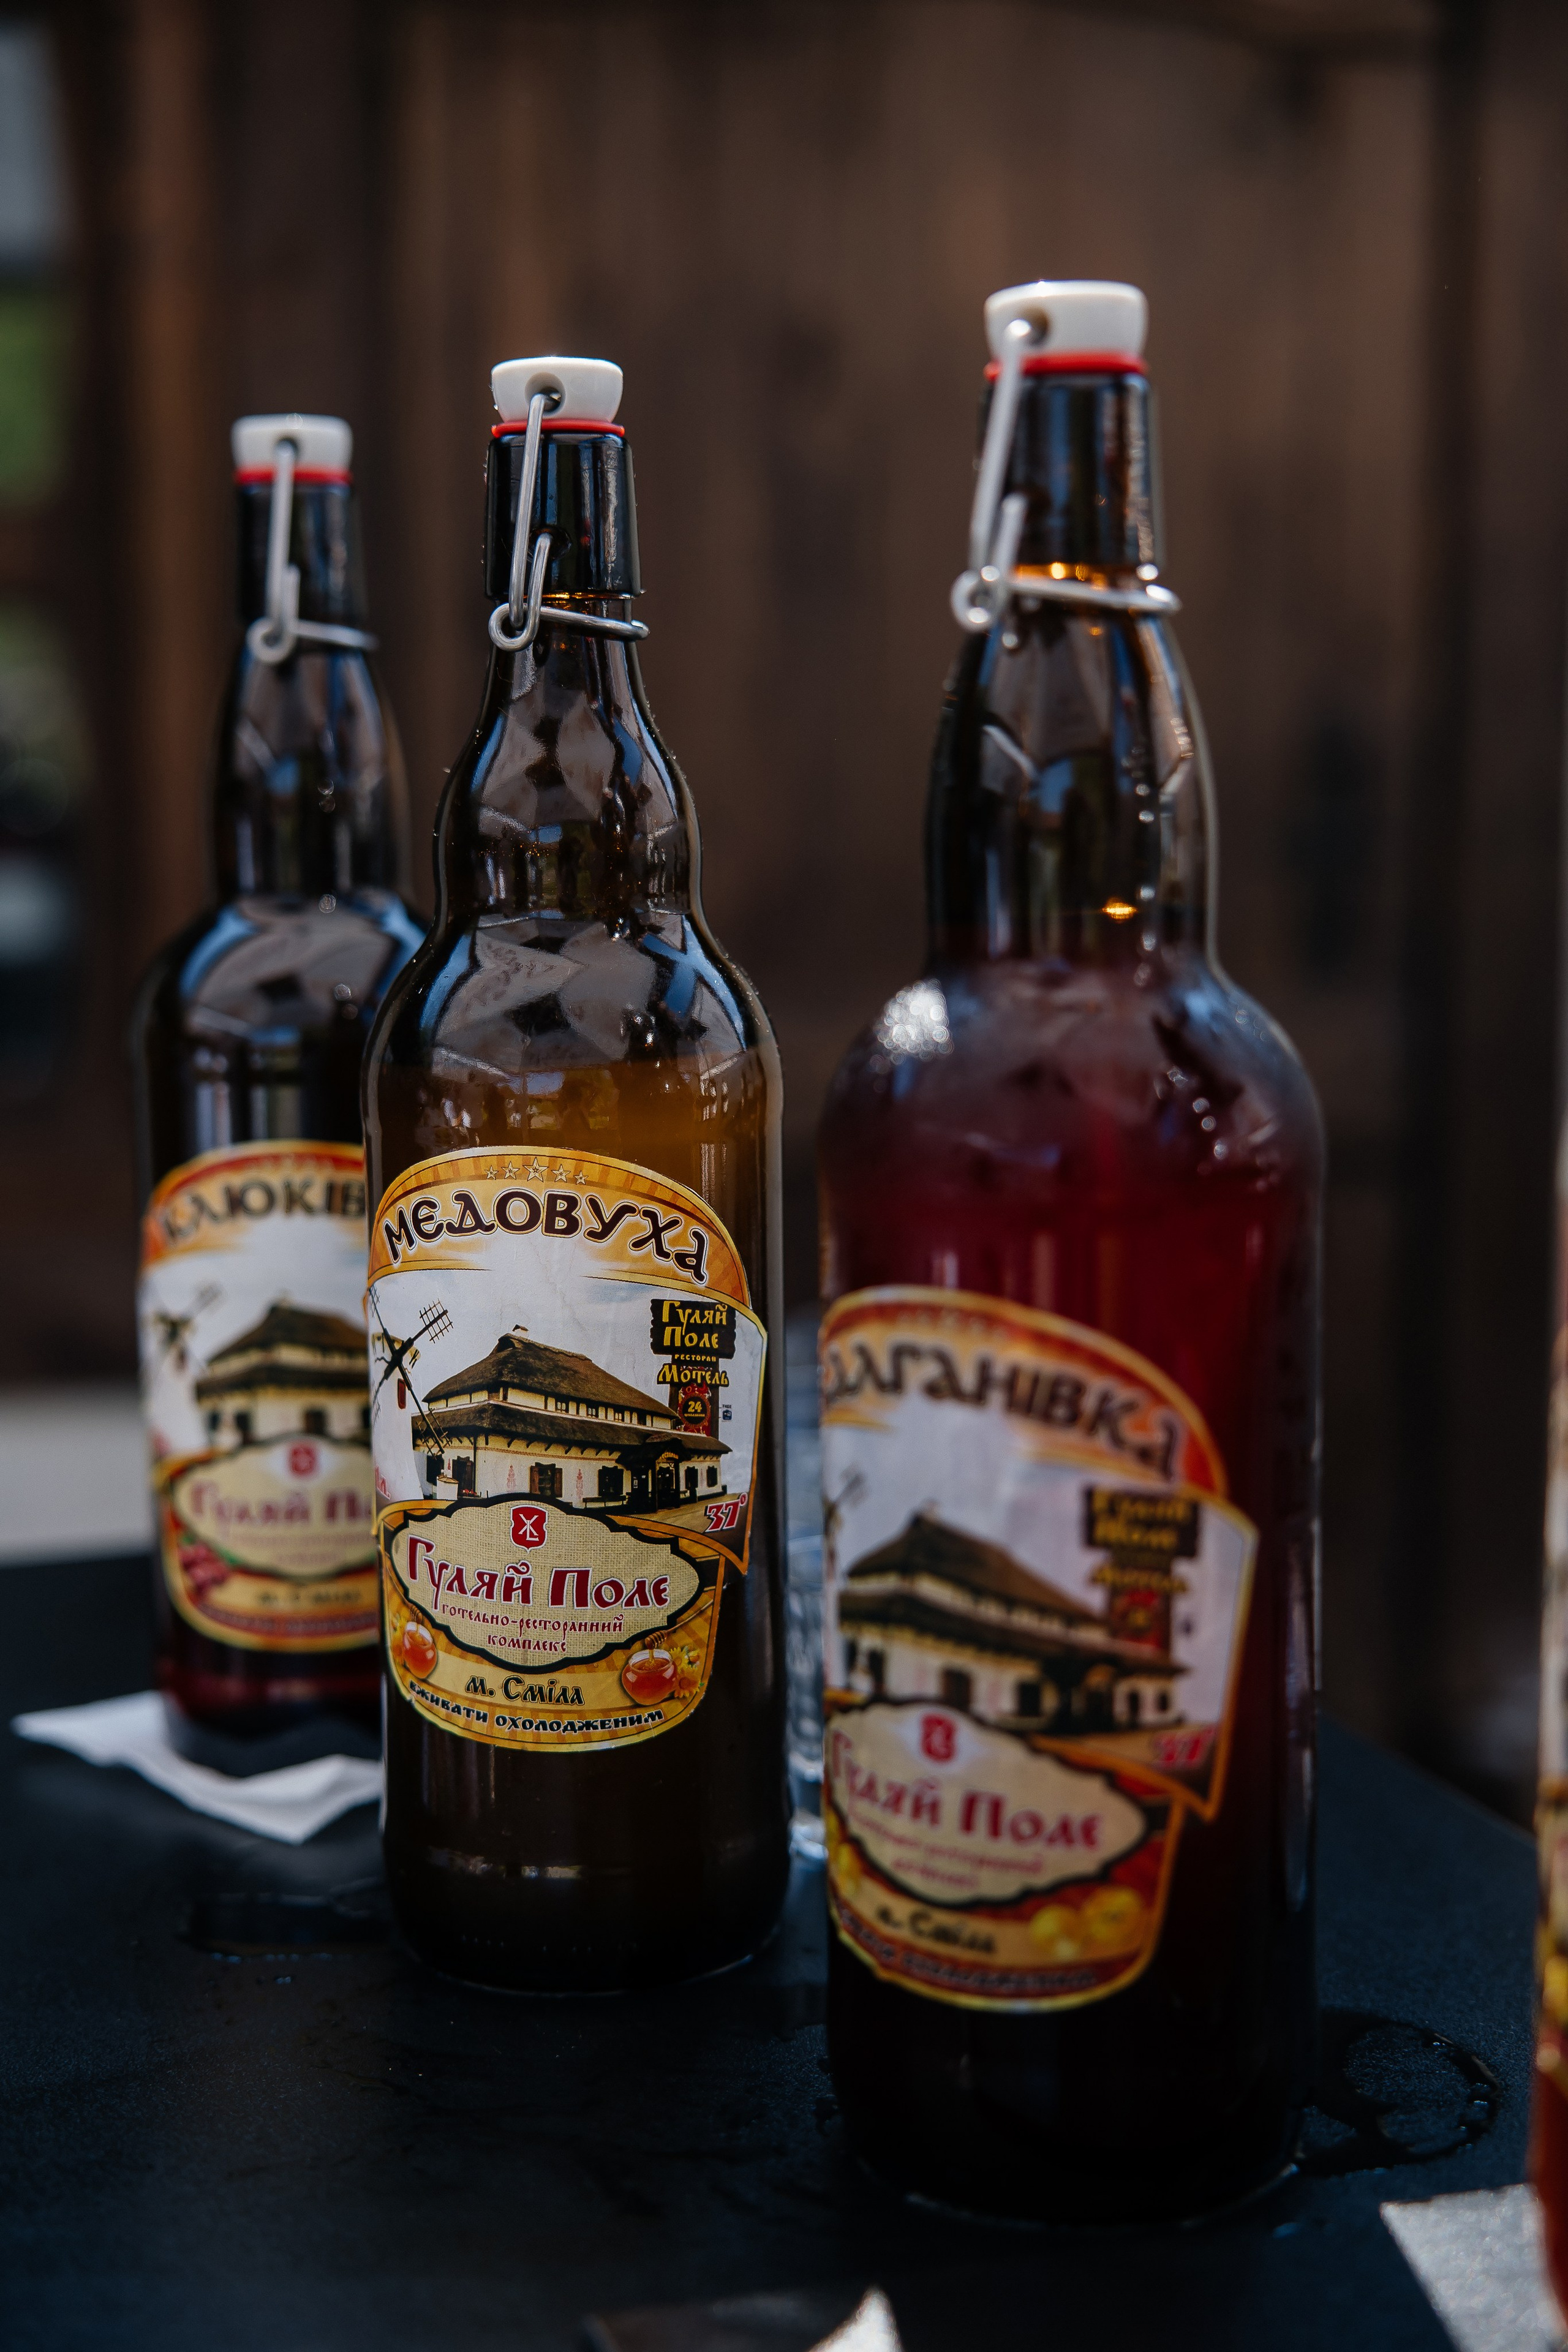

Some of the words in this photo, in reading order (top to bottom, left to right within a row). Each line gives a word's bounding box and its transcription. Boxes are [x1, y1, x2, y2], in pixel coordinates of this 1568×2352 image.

[384, 1191, 708, 1284] МЕДОВУХА
[662, 1300, 728, 1335] Гуляй
[663, 1326, 718, 1349] Поле
[674, 1354, 716, 1362] РЕСТОРАН
[688, 1401, 703, 1412] 24
[407, 1535, 533, 1610] Гуляй
[549, 1567, 671, 1610] Поле
[488, 1634, 567, 1653] комплекс
[502, 1675, 586, 1706] Сміла
[960, 1790, 1105, 1849] Поле
